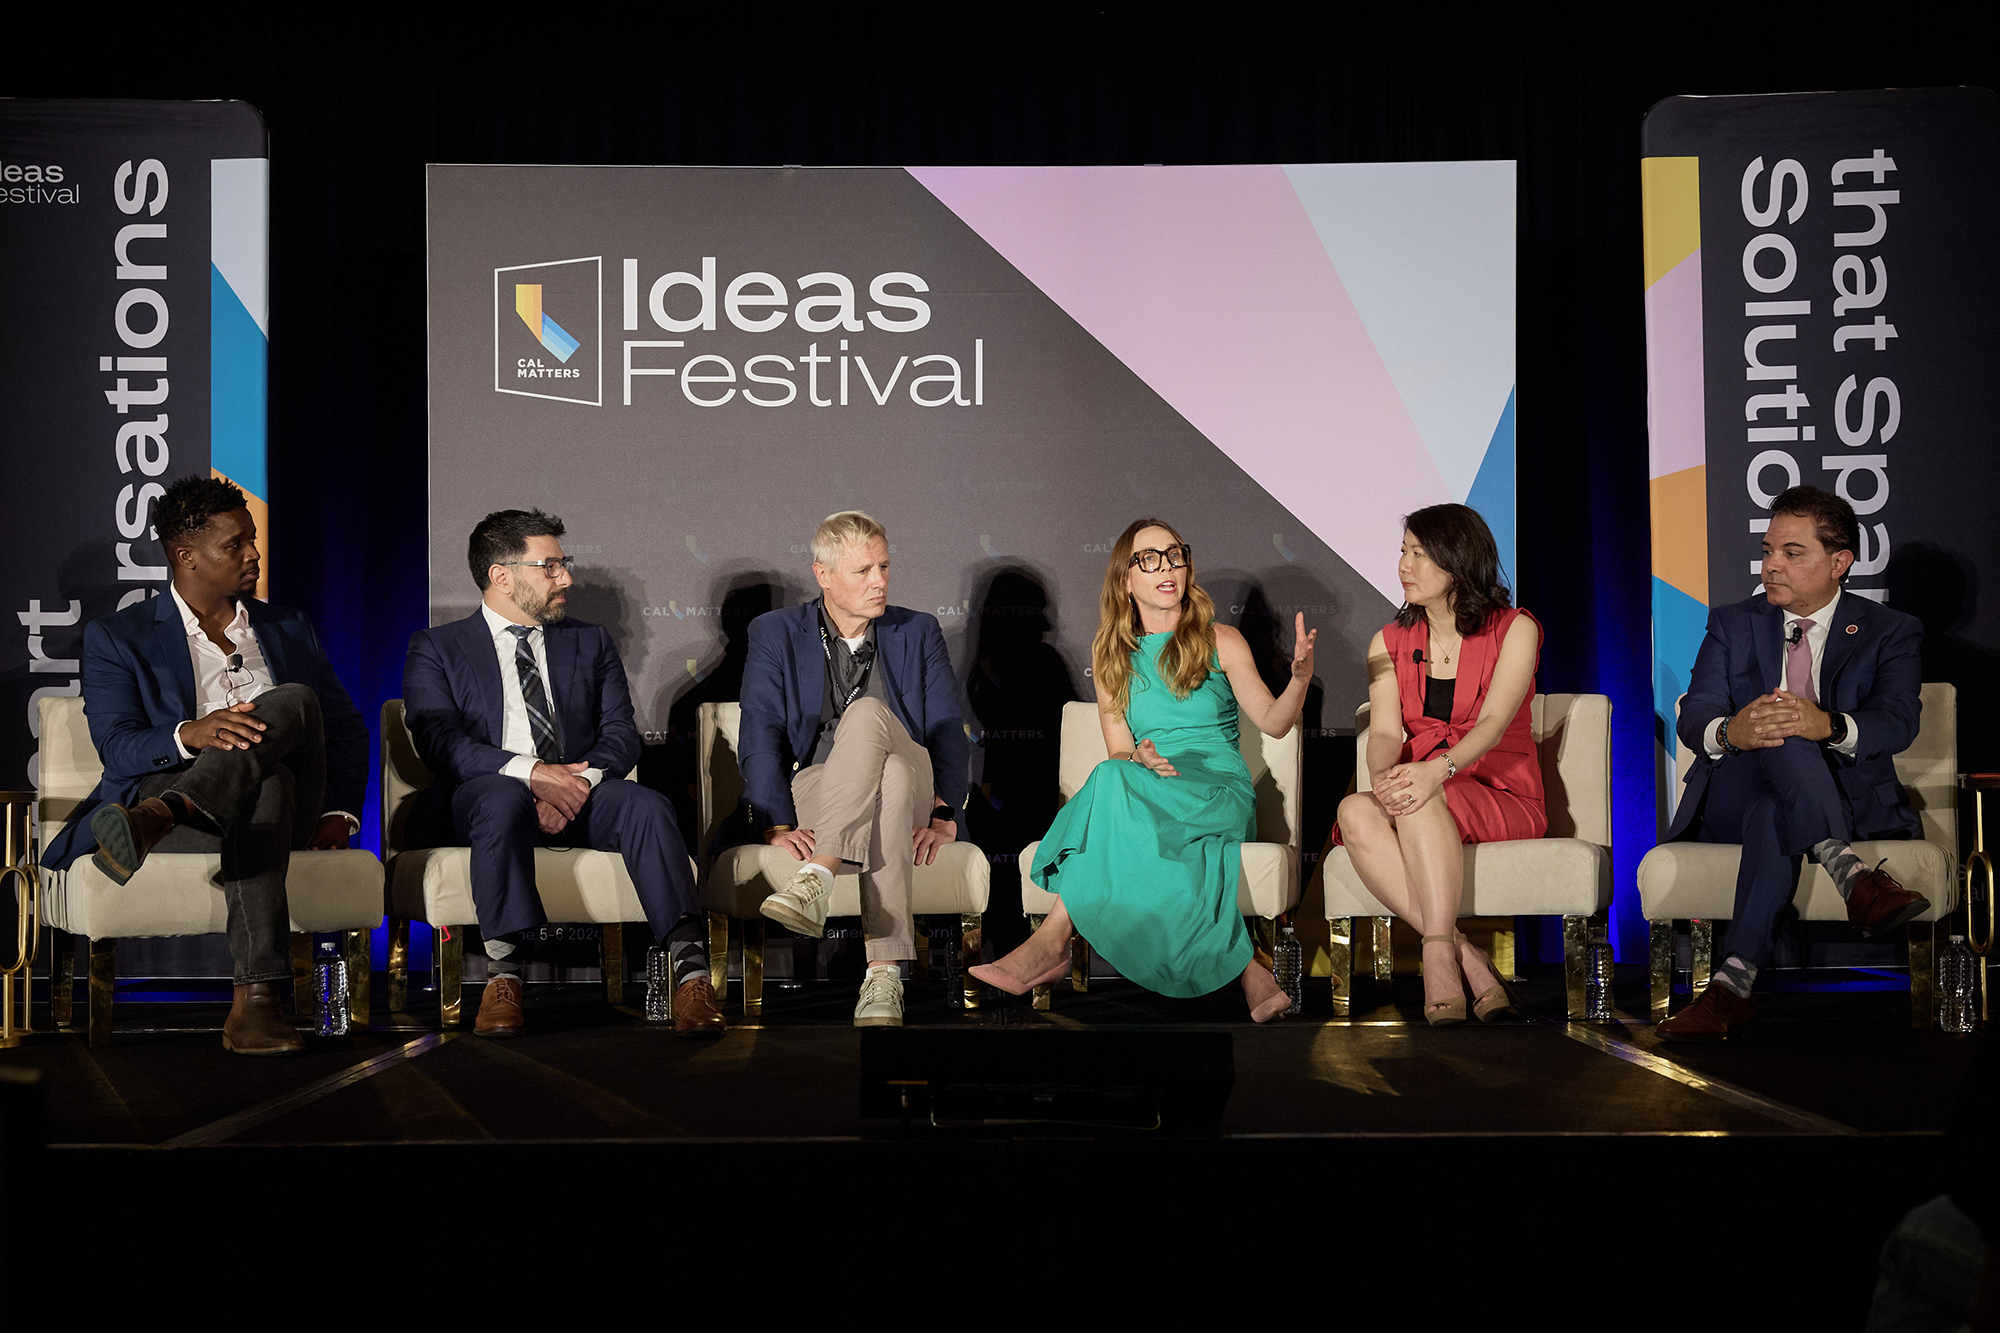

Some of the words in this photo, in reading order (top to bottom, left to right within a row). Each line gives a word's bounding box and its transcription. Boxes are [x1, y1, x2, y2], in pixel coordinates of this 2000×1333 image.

[0, 184, 81, 204] estival
[1830, 148, 1901, 352] that
[622, 256, 932, 333] Ideas
[517, 358, 545, 368] CAL
[517, 368, 581, 379] MATTERS
[622, 338, 984, 408] Festival
[1740, 156, 1816, 596] Solutio
[1821, 375, 1903, 605] Spa
[642, 606, 671, 617] CAL
[936, 606, 964, 616] CAL
[981, 729, 1045, 739] MATTERS
[539, 927, 564, 941] 5-6
